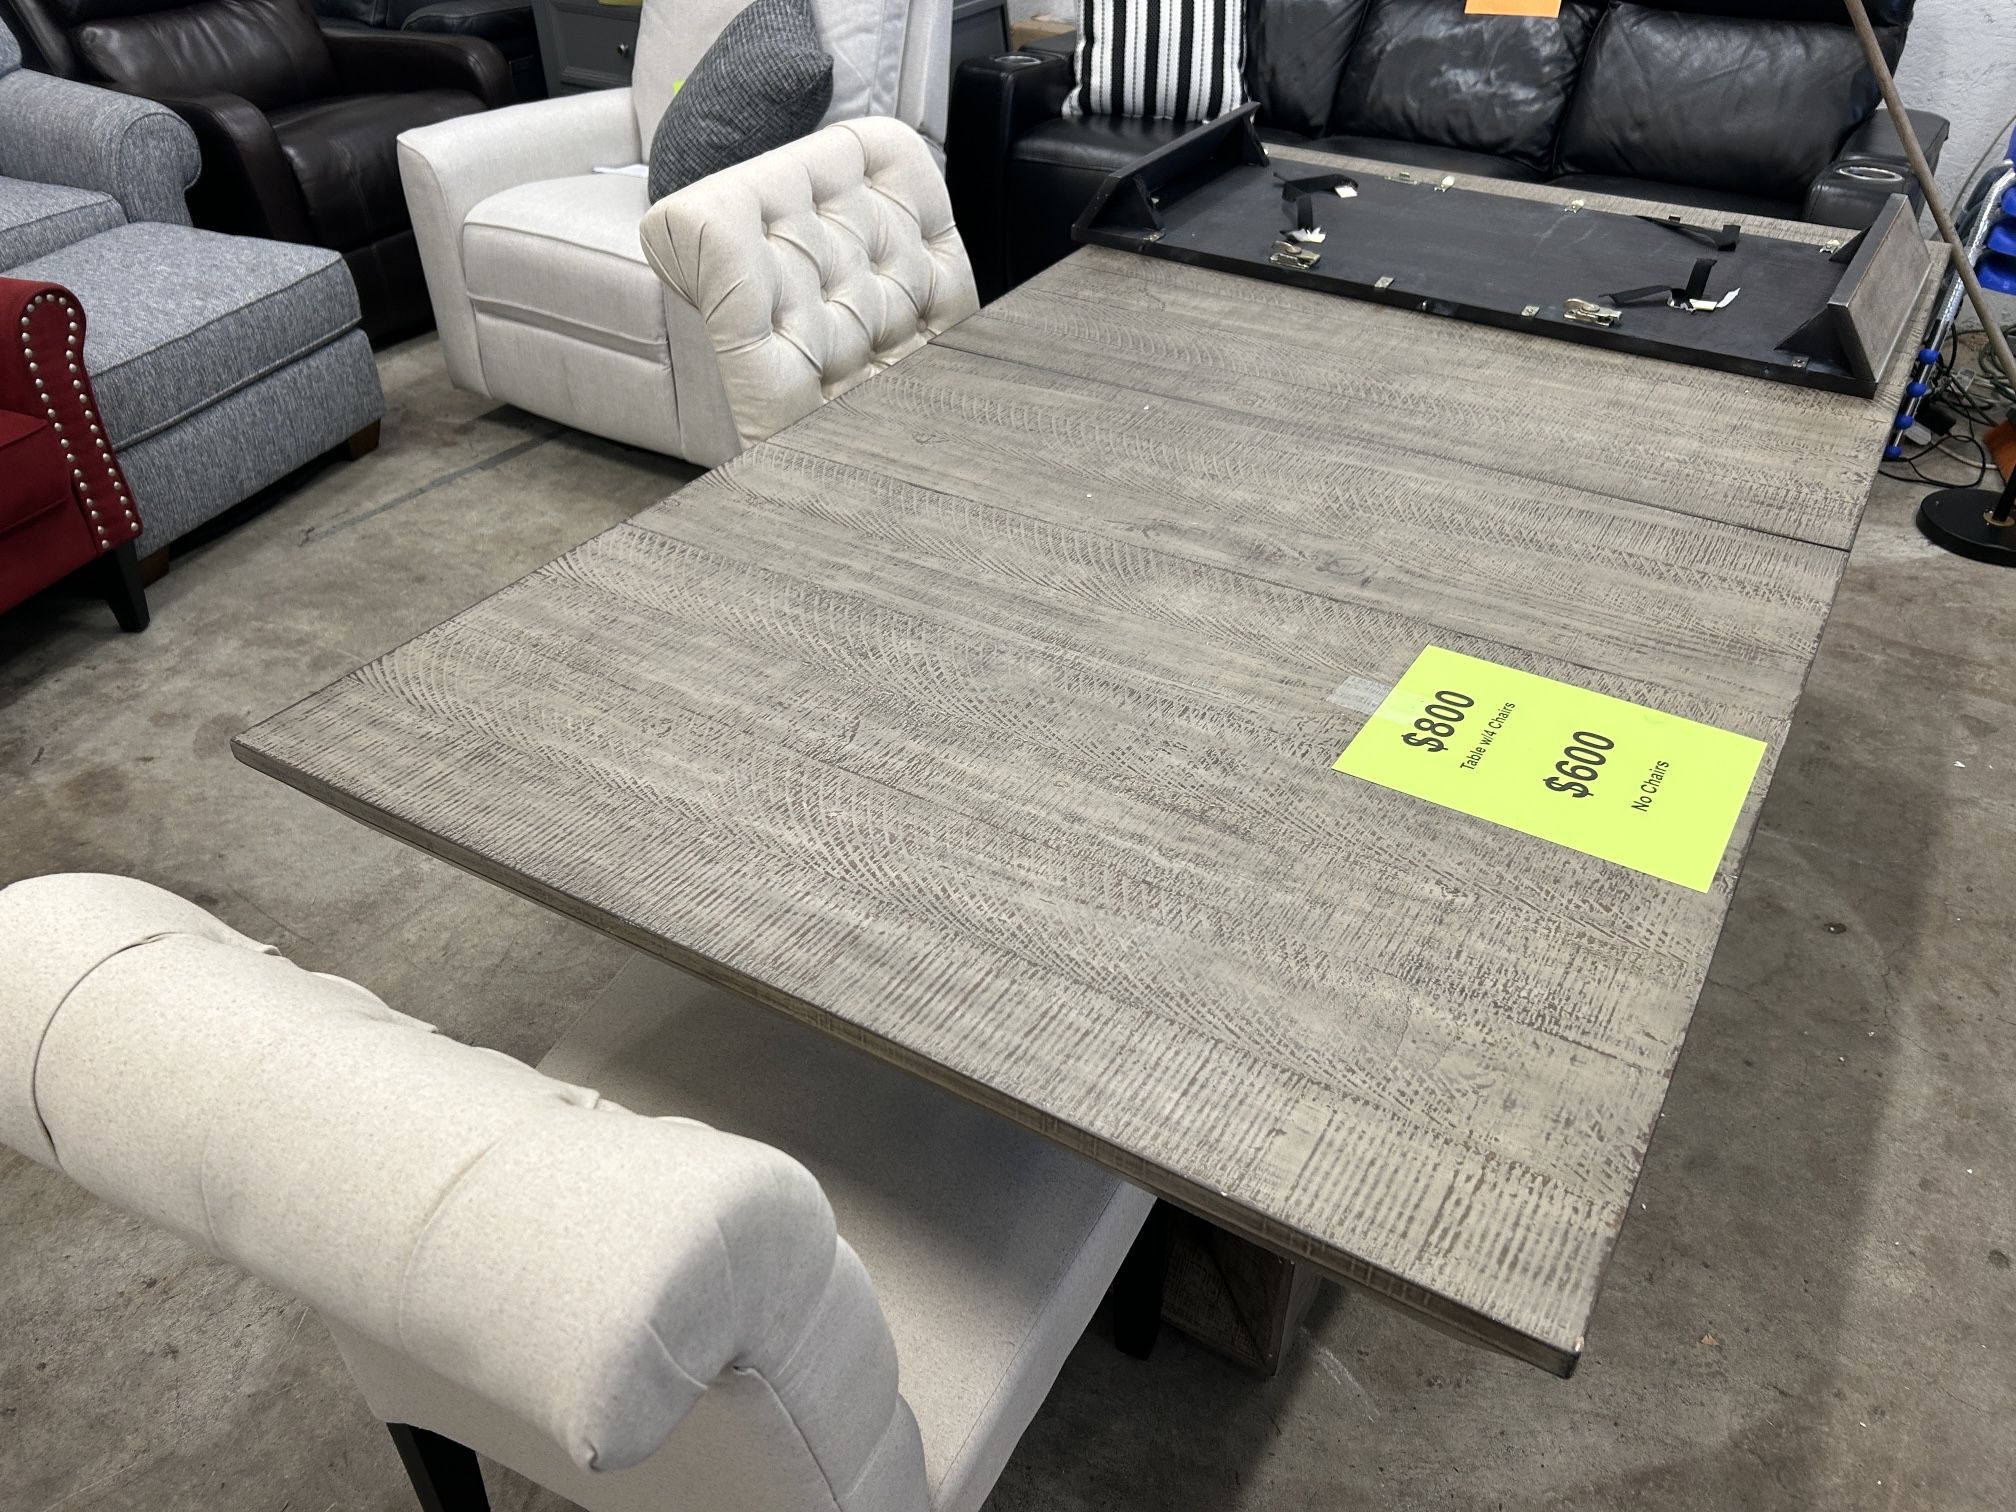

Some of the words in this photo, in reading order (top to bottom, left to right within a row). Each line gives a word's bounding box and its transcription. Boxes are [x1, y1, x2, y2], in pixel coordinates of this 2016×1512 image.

[1401, 690, 1475, 753] $800
[1488, 701, 1517, 730] Chairs
[1479, 729, 1498, 747] w/4
[1459, 745, 1487, 771] Table
[1542, 731, 1615, 798] $600
[1640, 760, 1670, 794] Chairs
[1630, 795, 1653, 812] No
